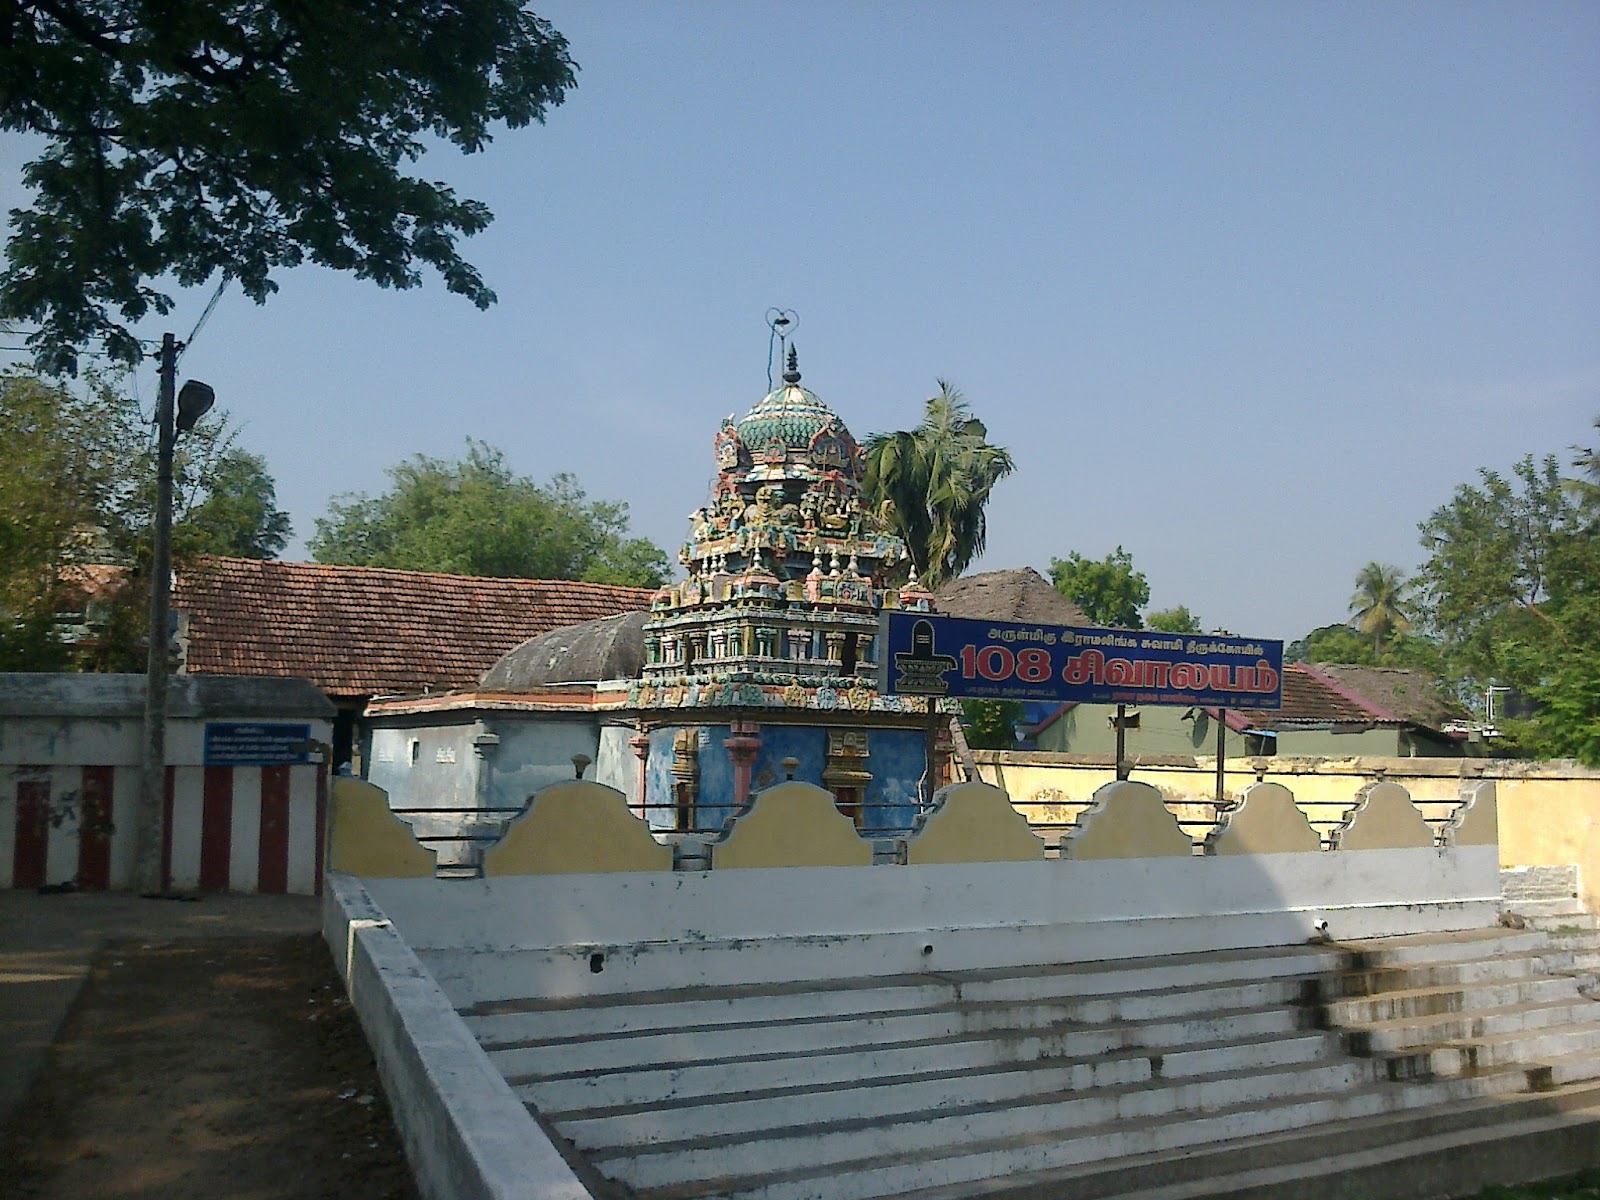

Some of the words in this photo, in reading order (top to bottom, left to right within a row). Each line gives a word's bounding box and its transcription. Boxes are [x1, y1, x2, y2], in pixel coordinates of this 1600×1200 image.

[987, 627, 1057, 645] அருள்மிகு
[1060, 630, 1138, 649] இராமலிங்க
[1141, 638, 1184, 651] சுவாமி
[1186, 639, 1265, 656] திருக்கோயில்
[960, 644, 1052, 683] 108
[1062, 649, 1280, 694] சிவாலயம்
